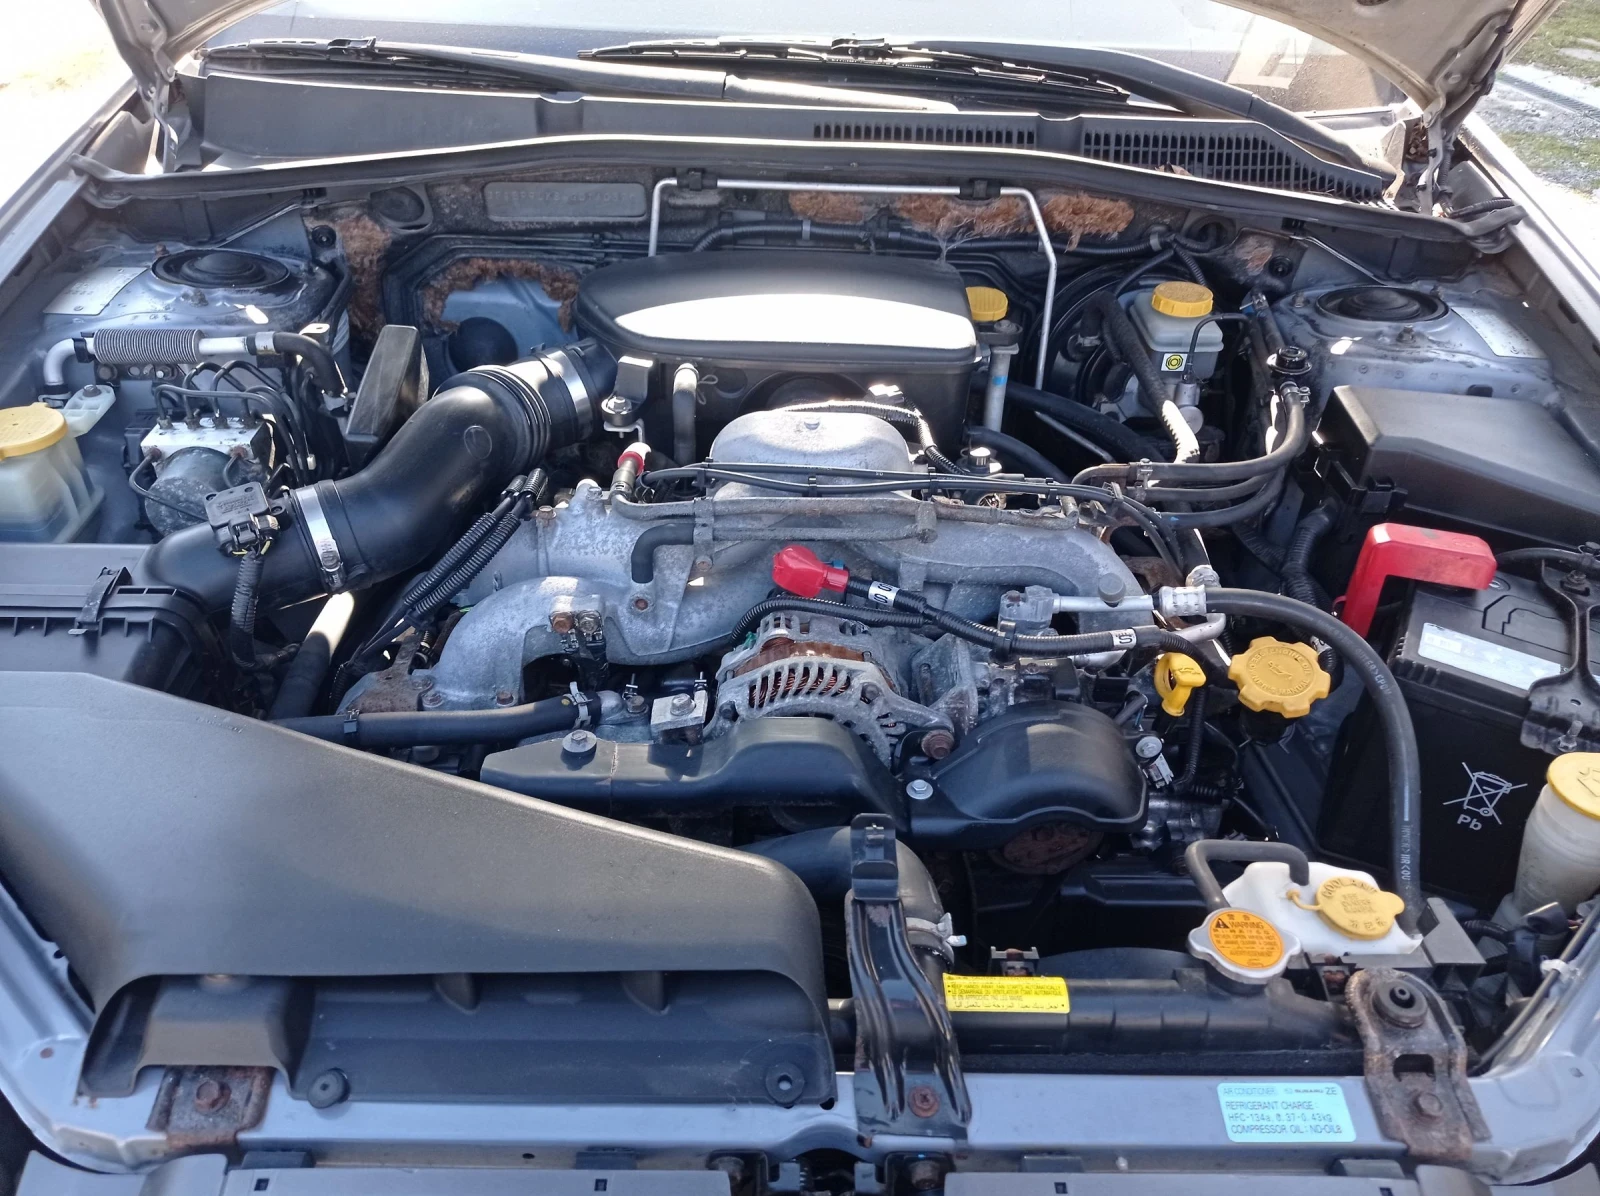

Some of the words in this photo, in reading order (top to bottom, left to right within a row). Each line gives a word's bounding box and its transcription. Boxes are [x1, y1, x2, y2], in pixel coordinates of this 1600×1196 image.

[1457, 814, 1482, 830] Pb
[1229, 921, 1264, 929] WARNING
[1325, 1087, 1337, 1095] ZE
[1226, 1101, 1278, 1110] REFRIGERANT
[1231, 1125, 1286, 1134] COMPRESSOR
